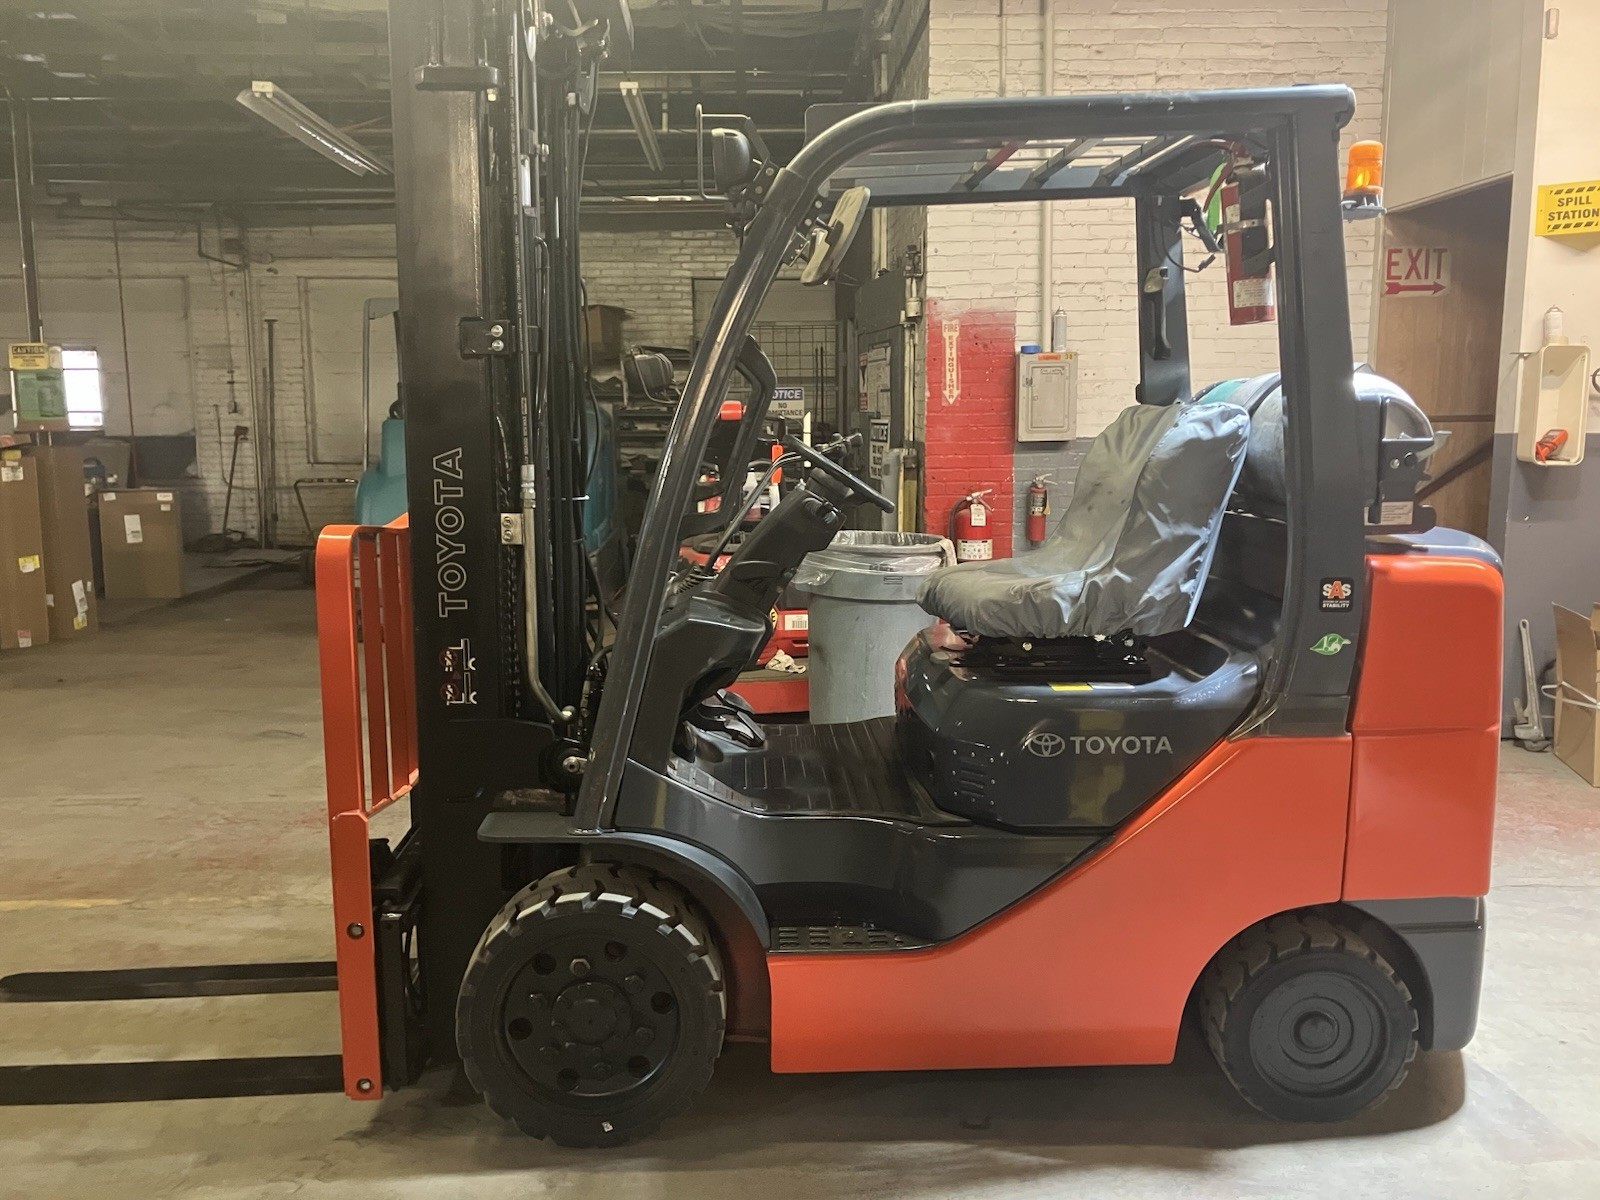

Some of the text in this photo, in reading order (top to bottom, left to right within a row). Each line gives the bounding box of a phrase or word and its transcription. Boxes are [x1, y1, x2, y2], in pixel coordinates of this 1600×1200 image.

[1557, 195, 1592, 207] SPILL
[1547, 207, 1600, 221] STATION
[1385, 247, 1448, 280] EXIT
[943, 323, 958, 333] FIRE
[947, 335, 955, 400] EXTINGUISHER
[772, 389, 802, 399] OTICE
[433, 446, 468, 618] TOYOTA
[1322, 580, 1352, 599] SAS
[1069, 735, 1173, 755] TOYOTA
